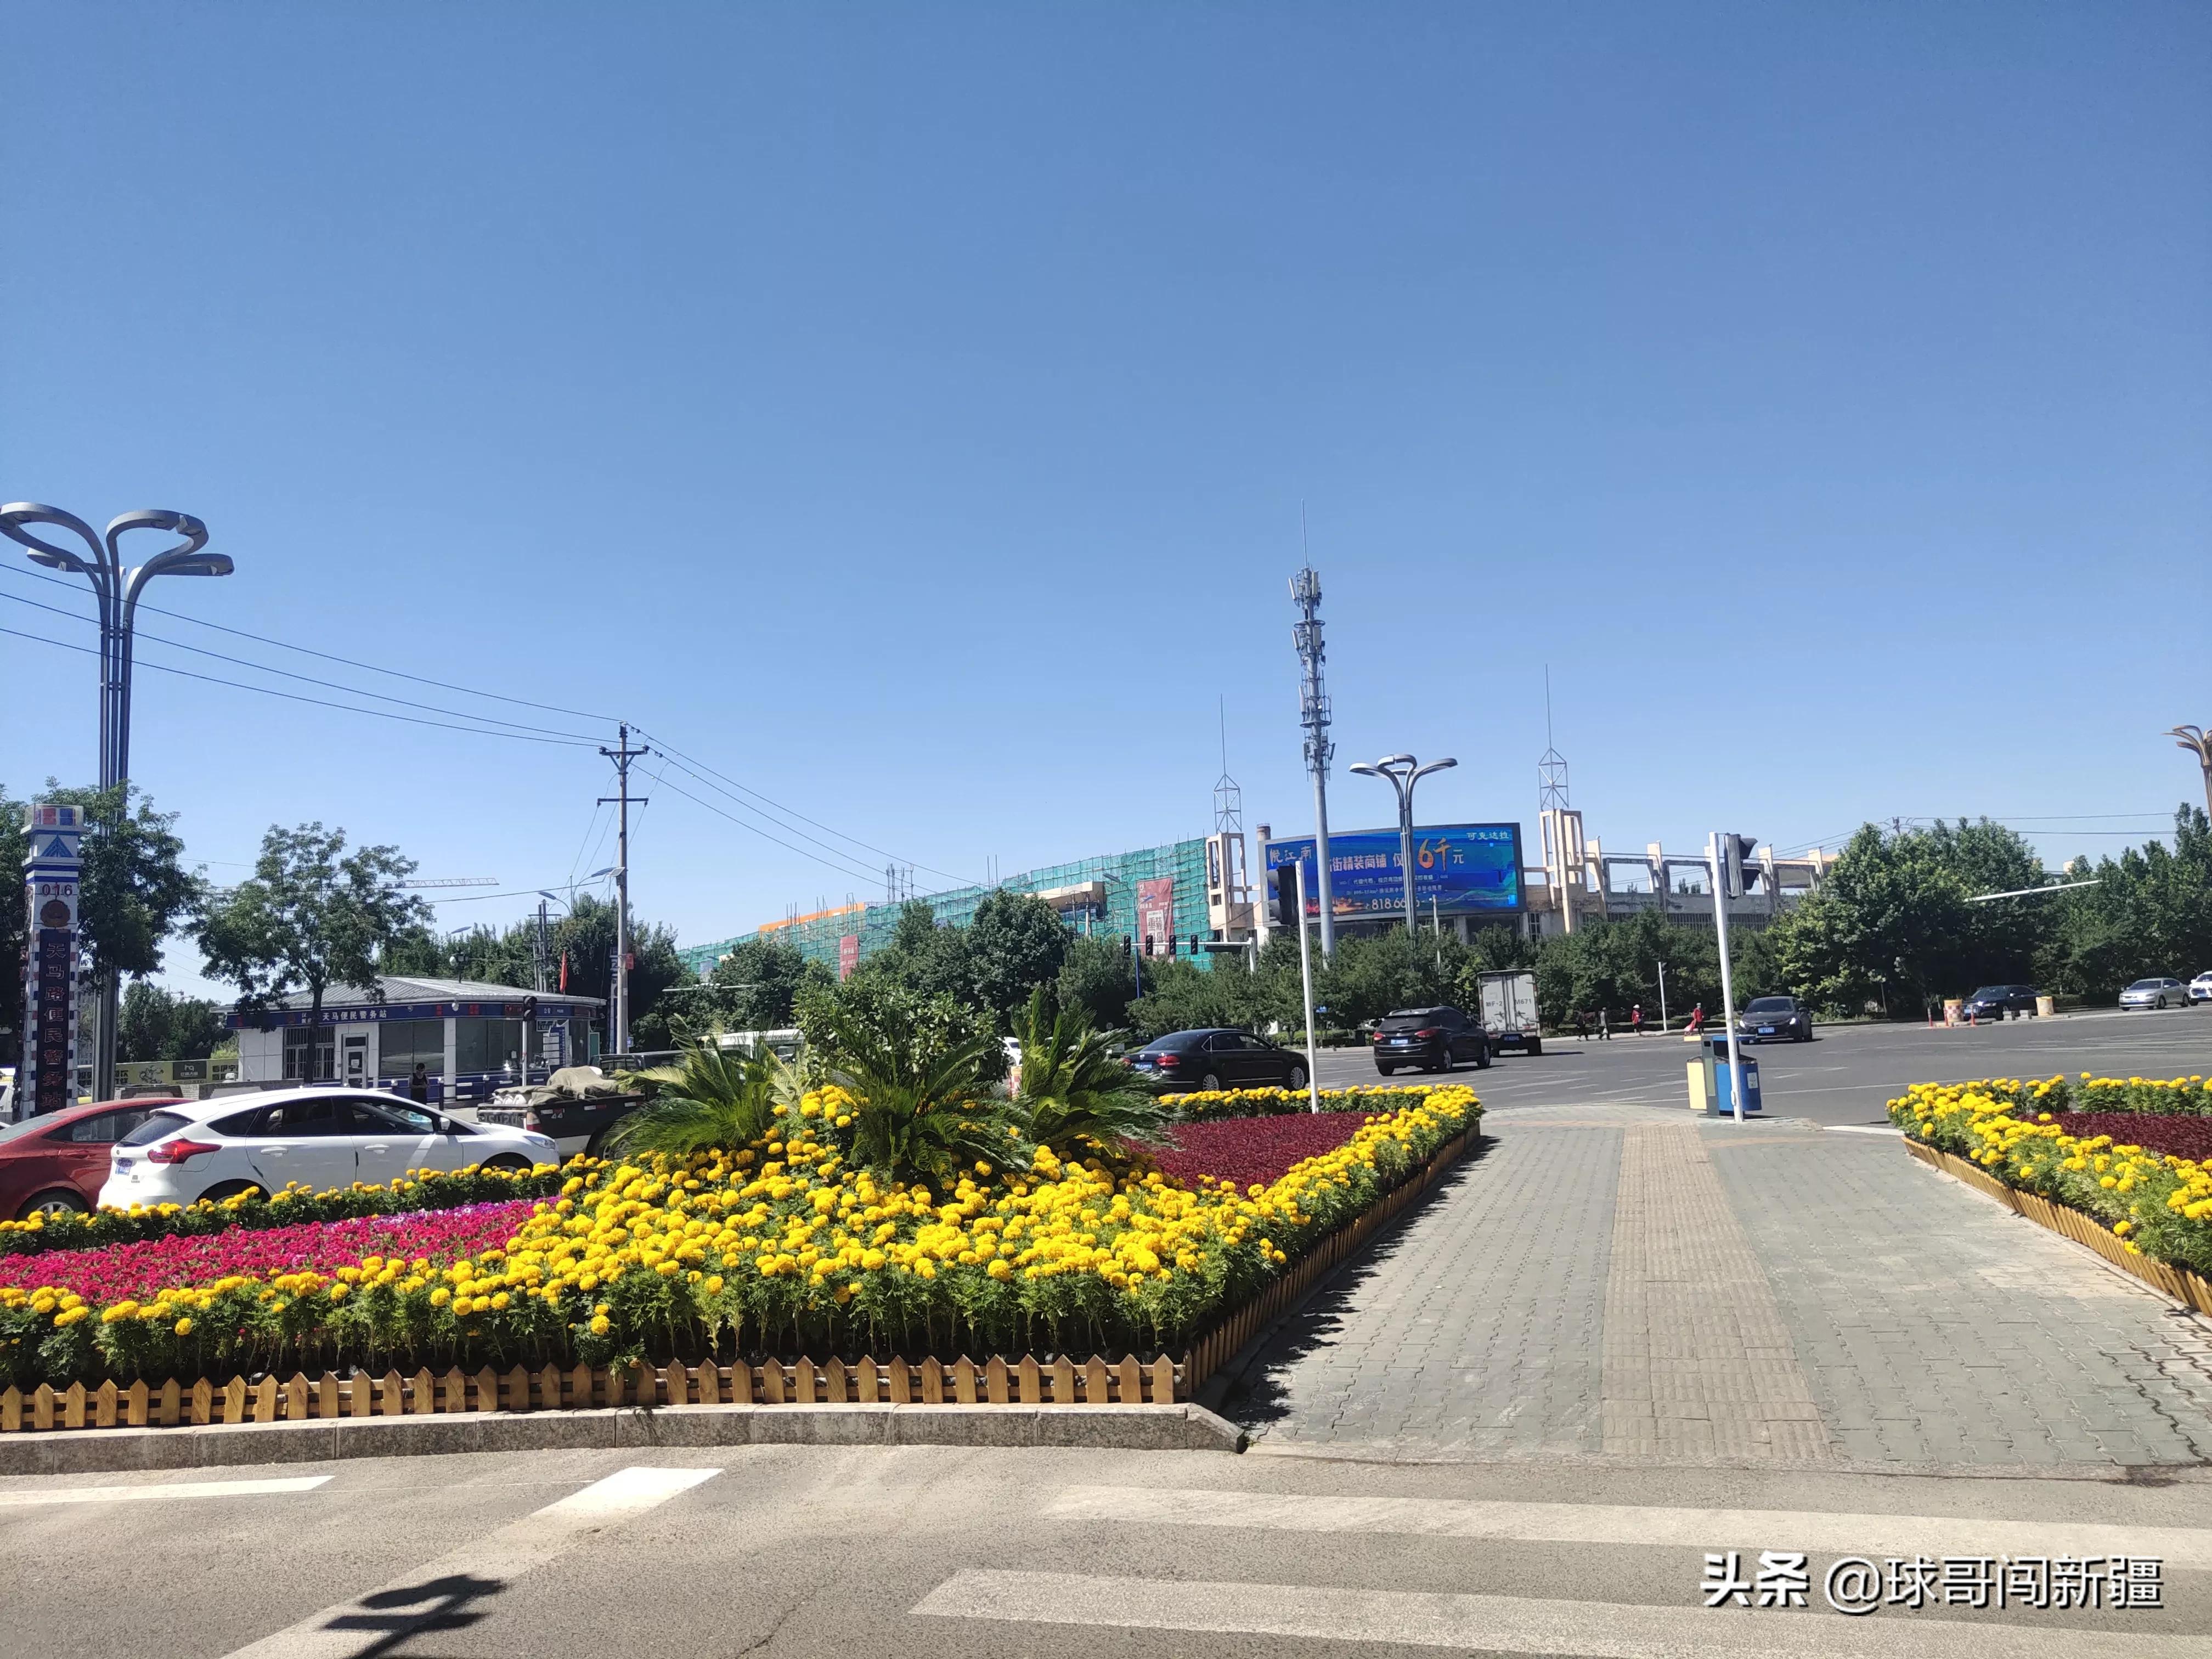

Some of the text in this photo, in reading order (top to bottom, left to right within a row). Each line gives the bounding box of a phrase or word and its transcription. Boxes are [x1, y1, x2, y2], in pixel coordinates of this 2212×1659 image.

[1466, 831, 1509, 840] 可克达拉
[42, 884, 73, 896] 016
[323, 1009, 387, 1021] 天马便民警务站
